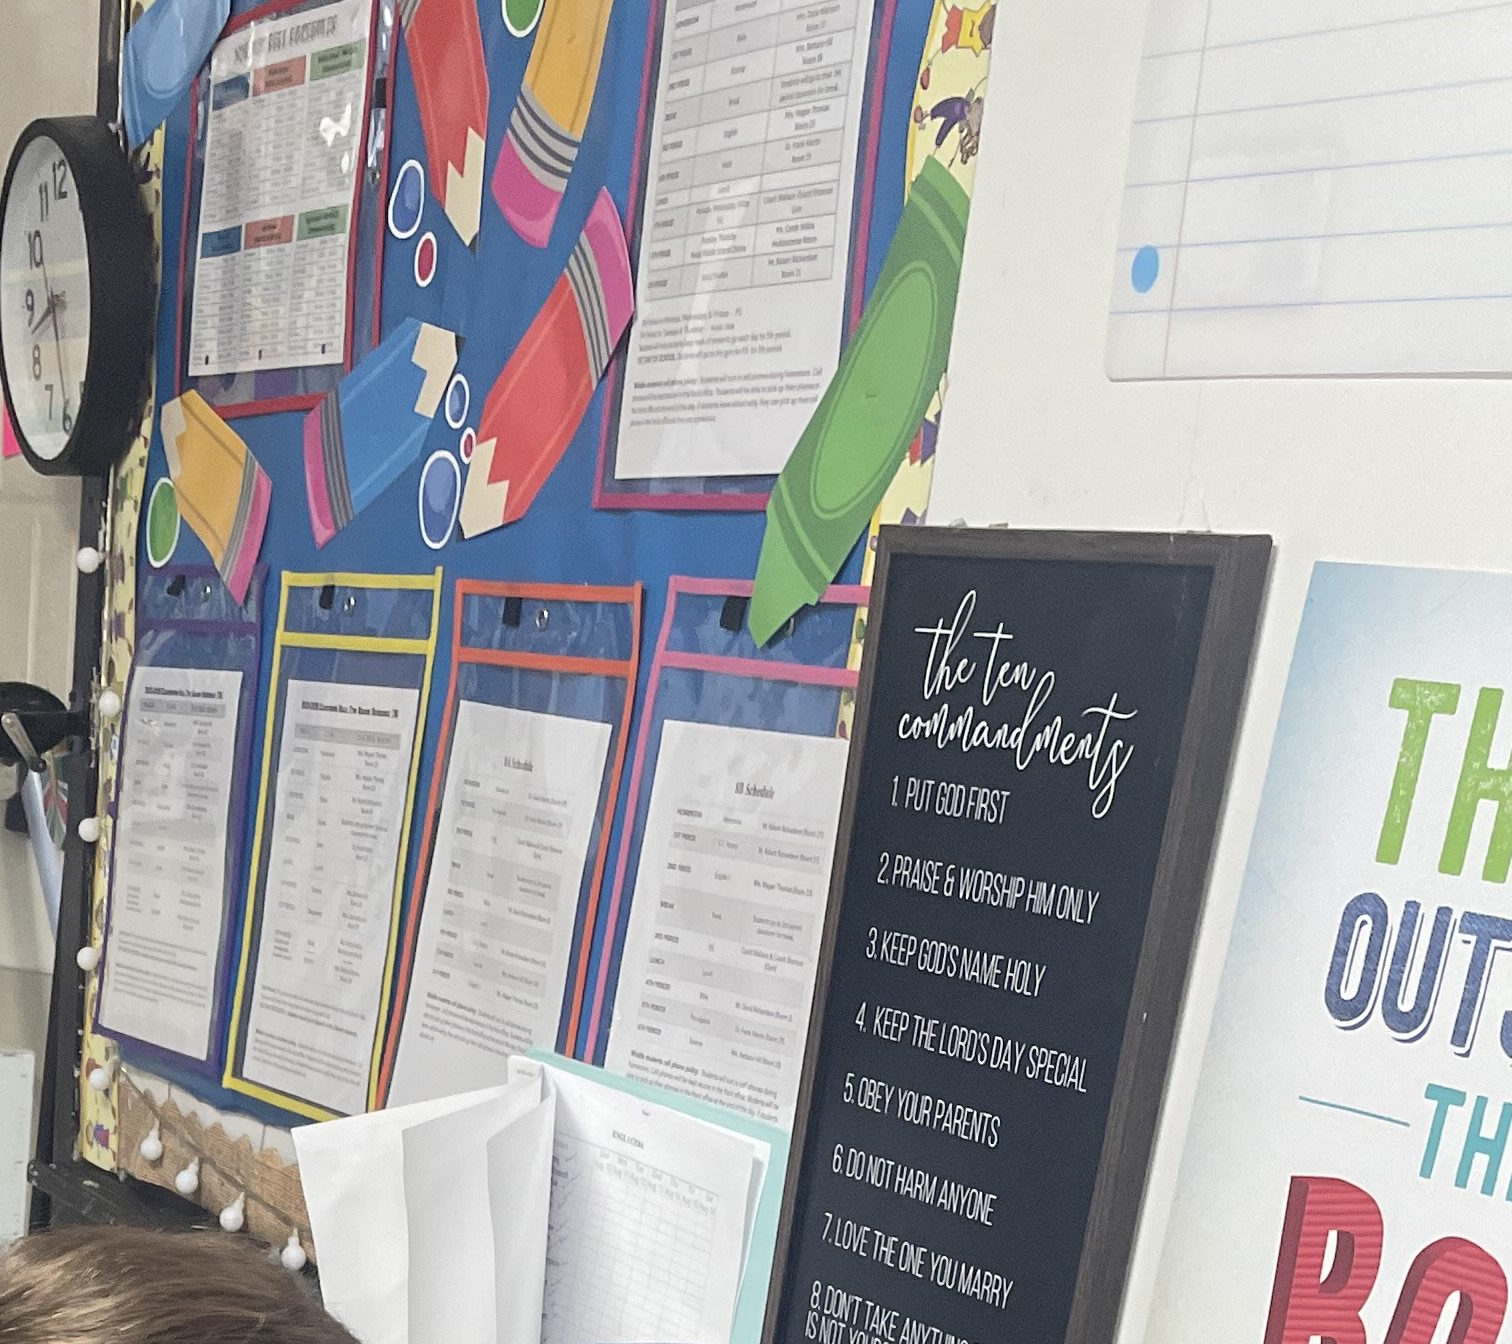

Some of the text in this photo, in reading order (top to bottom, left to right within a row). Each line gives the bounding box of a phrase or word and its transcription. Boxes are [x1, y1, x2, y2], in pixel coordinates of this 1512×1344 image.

[39, 182, 48, 222] 11
[53, 159, 68, 200] 12
[28, 230, 42, 270] 10
[25, 289, 34, 327] 9
[32, 345, 41, 380] 8
[45, 385, 53, 420] 7
[63, 406, 72, 434] 6
[915, 589, 1036, 705] the ten
[898, 671, 1138, 819] commandments
[891, 775, 1011, 824] 1. PUT GOD FIRST
[877, 851, 1100, 925] 2. PRAISE & WORSHIP HIM ONLY
[865, 926, 1047, 997] 3. KEEP GOD'S NAME HOLY
[855, 1001, 1087, 1093] 4. KEEP THE LORD'S DAY SPECIAL
[843, 1072, 1001, 1148] 5. OBEY YOUR PARENTS
[832, 1143, 998, 1226] 6. DO NOT HARM ANYONE
[822, 1212, 1014, 1310] 7. LOVE THE ONE YOU MARRY
[804, 1310, 819, 1340] IS
[810, 1280, 822, 1311] 8.
[823, 1285, 863, 1326] DON'T
[864, 1300, 900, 1342] TAKE
